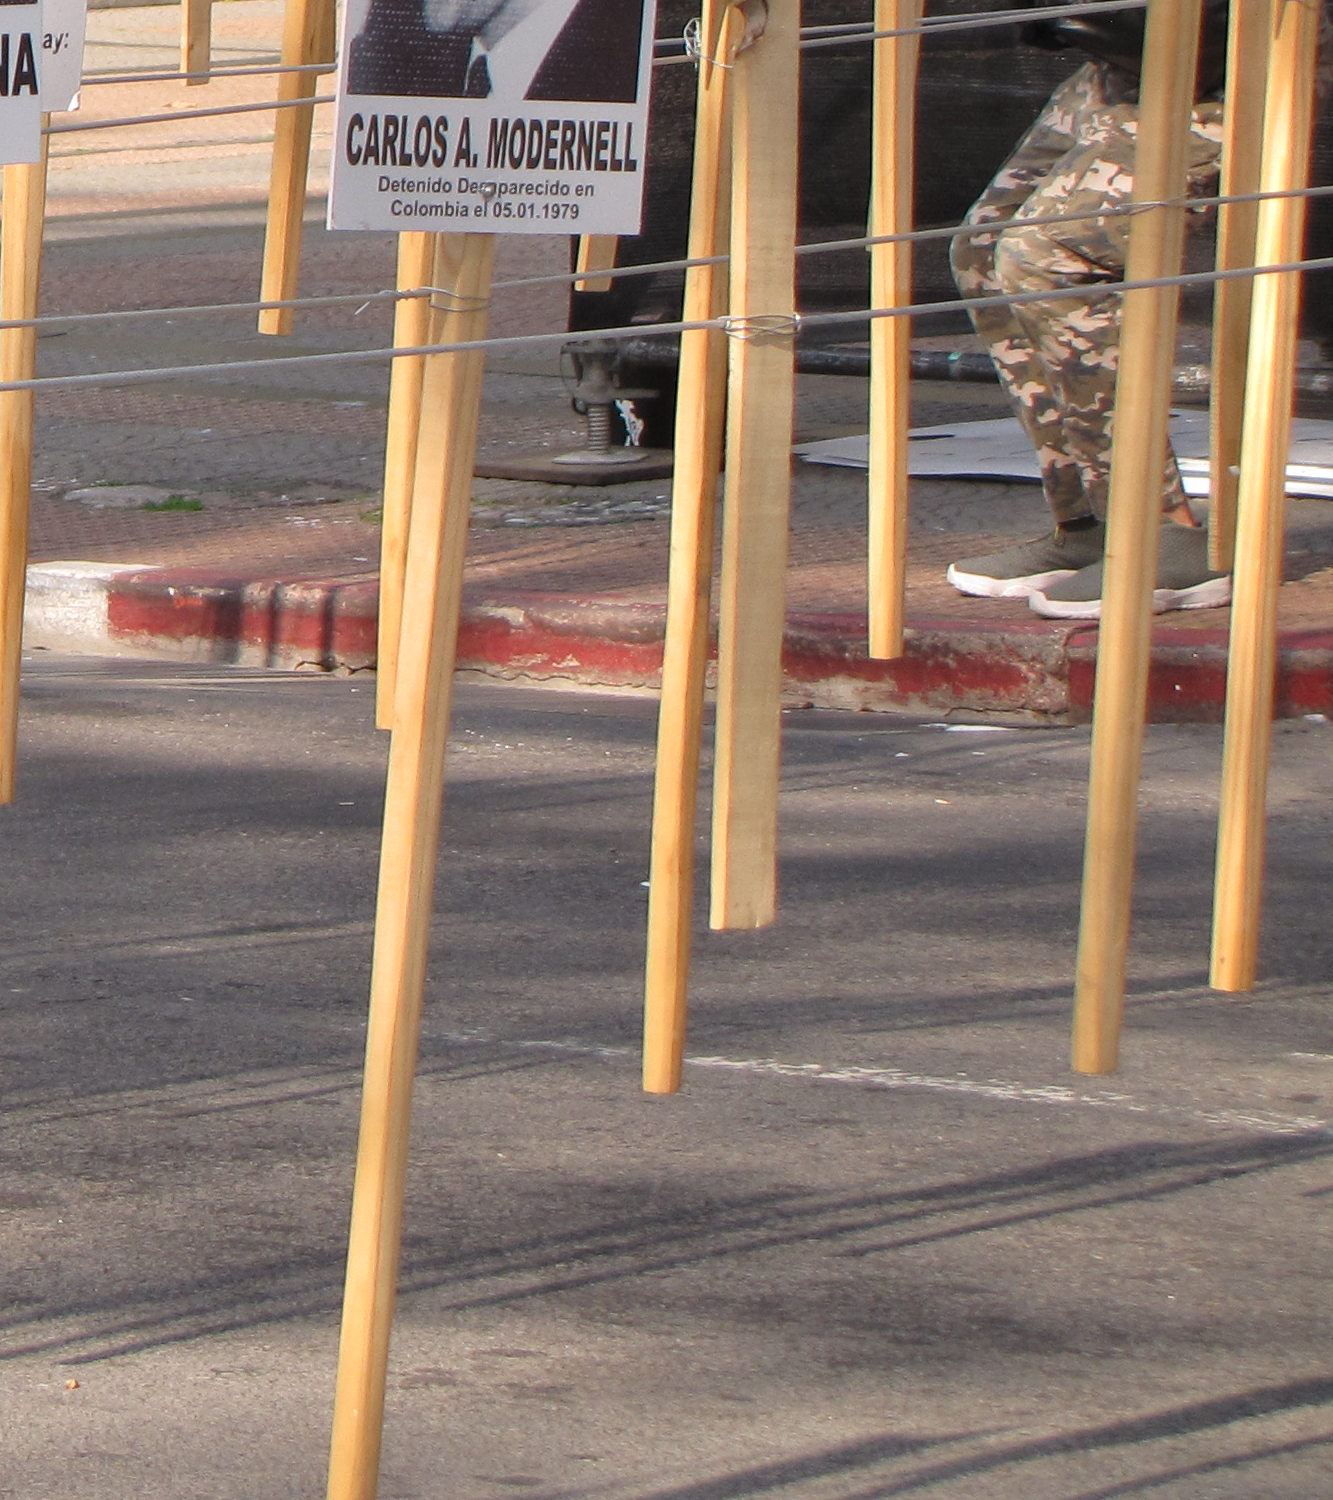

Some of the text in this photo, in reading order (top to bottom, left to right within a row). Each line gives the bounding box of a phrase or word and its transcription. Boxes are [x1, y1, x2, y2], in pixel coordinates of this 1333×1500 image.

[346, 112, 637, 172] CARLOS A. MODERNELL
[378, 176, 452, 194] Detenido
[575, 183, 595, 197] en
[390, 199, 579, 220] Colombia el 05.01.1979
